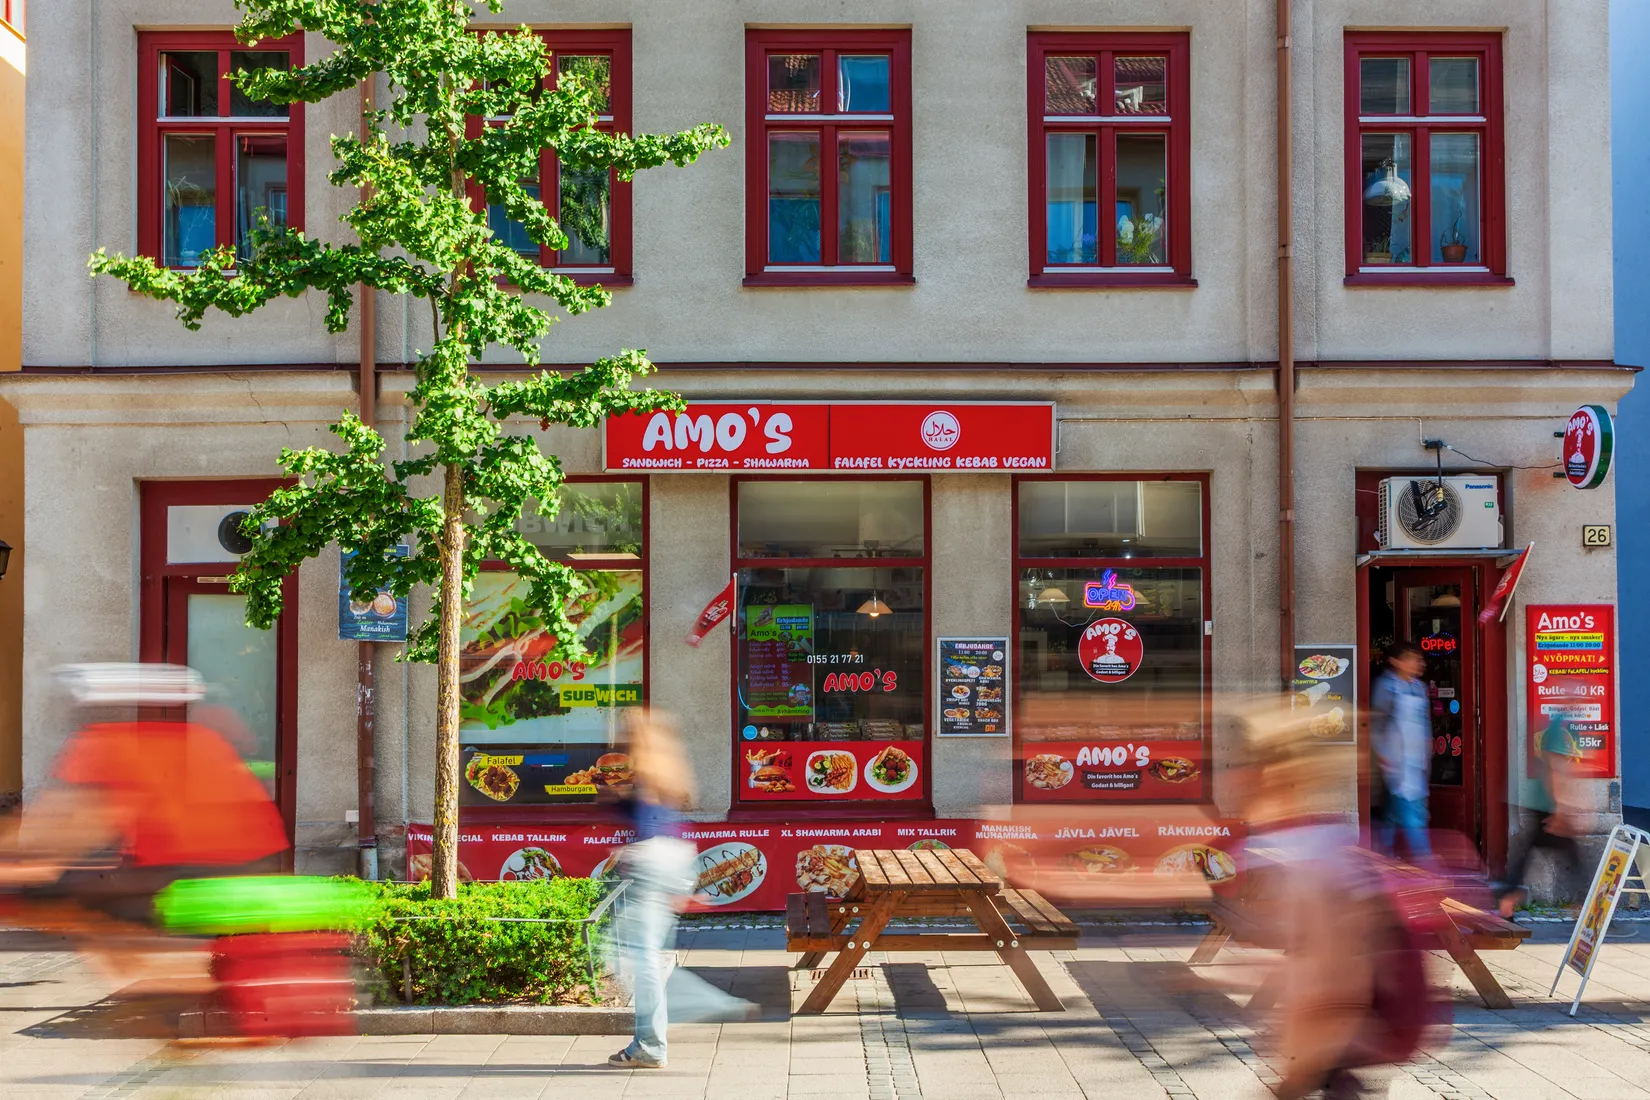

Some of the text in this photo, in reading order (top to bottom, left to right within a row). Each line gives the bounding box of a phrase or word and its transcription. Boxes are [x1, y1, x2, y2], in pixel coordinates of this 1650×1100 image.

[642, 407, 793, 454] AMO'S
[926, 421, 956, 437] حلال
[1567, 416, 1594, 436] AMO'S
[622, 458, 682, 468] SANDWICH
[696, 458, 729, 468] PIZZA
[744, 458, 809, 468] SHAWARMA
[834, 456, 1046, 470] FALAFEL KYCKLING KEBAB VEGAN
[1587, 528, 1607, 542] 26
[1088, 588, 1127, 602] OPEN
[1537, 612, 1595, 630] Amo's
[1086, 623, 1137, 641] AMO'S
[807, 655, 827, 664] 0155
[830, 655, 839, 664] 21
[842, 654, 852, 664] 77
[855, 654, 864, 664] 21
[1544, 652, 1596, 662] NYÖPPNAT!
[512, 660, 586, 682] AMO'S
[824, 668, 897, 692] AMO'S
[1538, 686, 1604, 696] Rulle 40 KR
[563, 690, 636, 704] SUBWICH
[1580, 737, 1602, 748] 55kr
[487, 756, 516, 765] Falafel
[1076, 744, 1150, 768] AMO'S
[551, 785, 593, 794] Hamburgare
[739, 829, 770, 837] RULLE
[796, 829, 850, 837] SHAWARMA
[852, 828, 882, 836] ARABI
[898, 828, 957, 836] MIX TALLRIK
[981, 824, 1032, 832] MANAKISH
[1055, 827, 1140, 838] JÄVLA JÄVEL
[1158, 824, 1231, 837] RÄKMACKA
[408, 834, 434, 842] VIKIN
[492, 834, 567, 842] KEBAB TALLRIK
